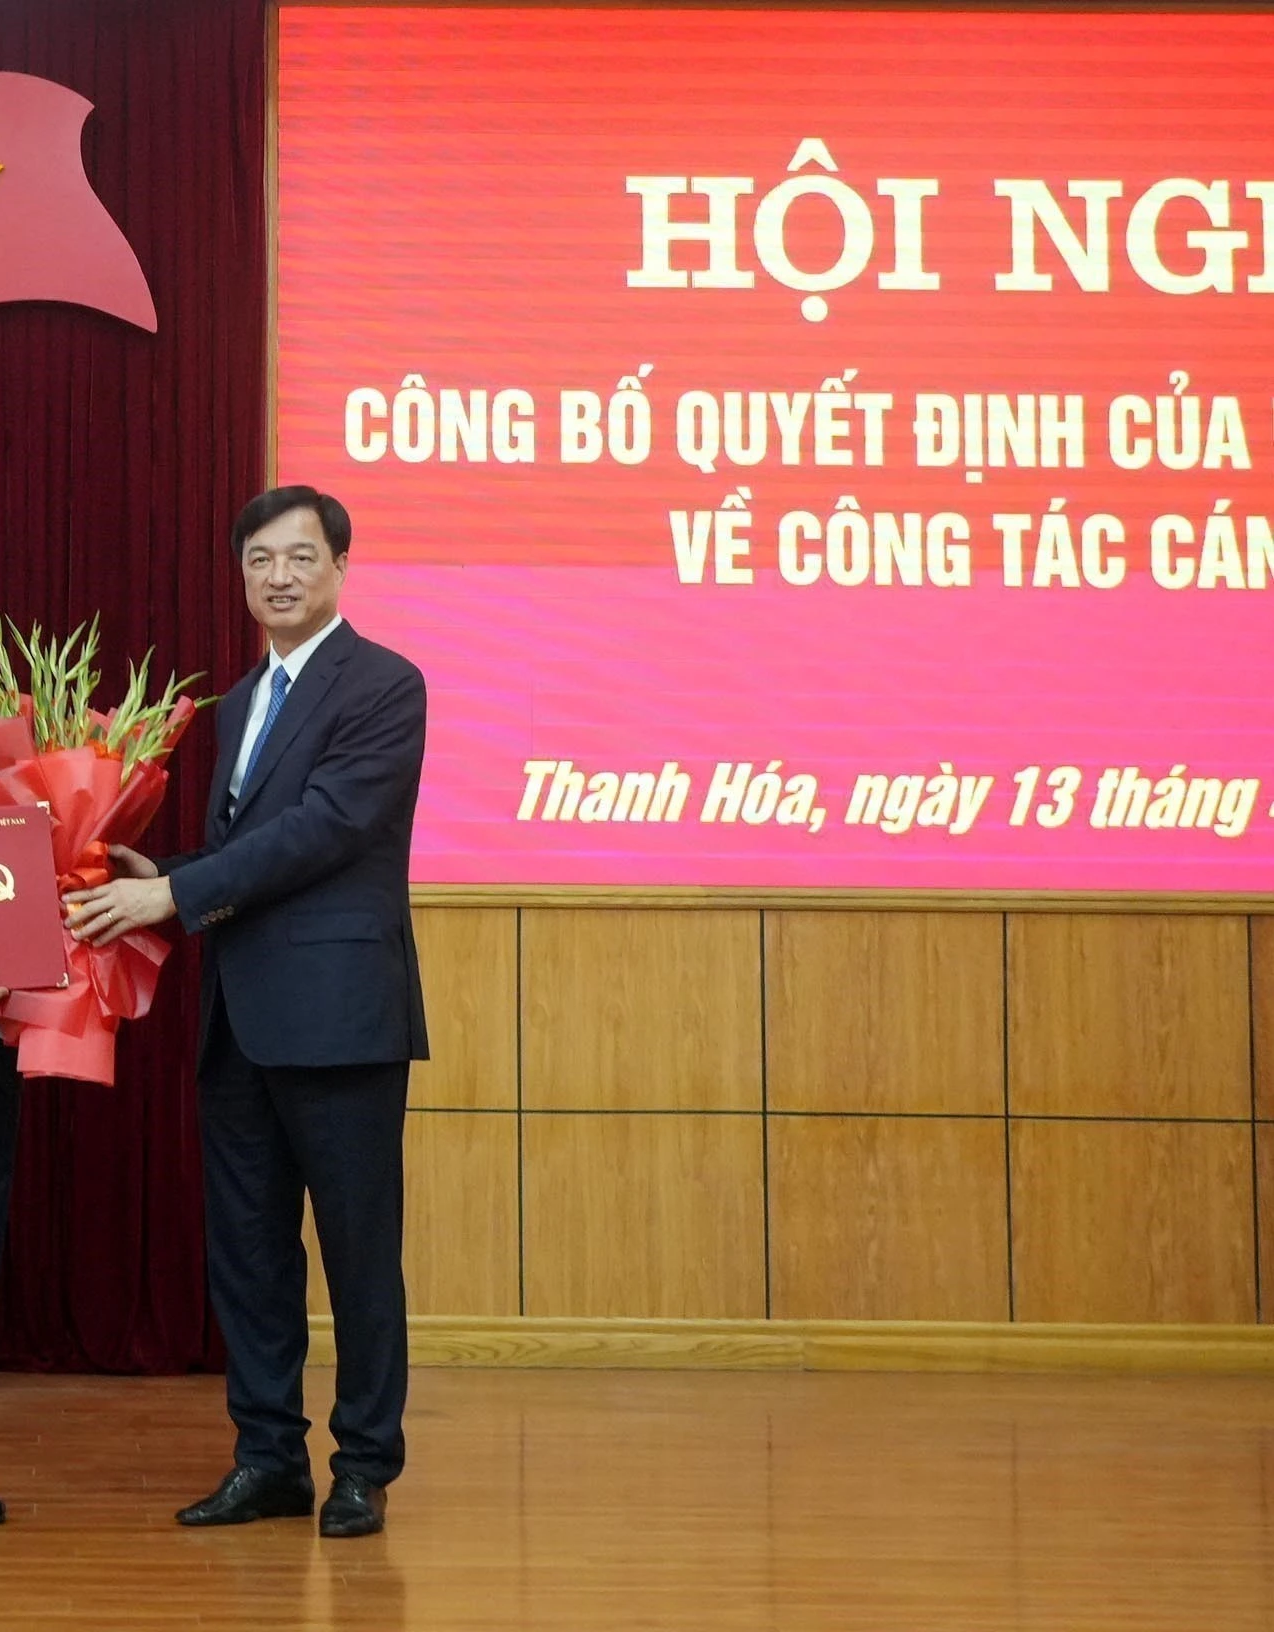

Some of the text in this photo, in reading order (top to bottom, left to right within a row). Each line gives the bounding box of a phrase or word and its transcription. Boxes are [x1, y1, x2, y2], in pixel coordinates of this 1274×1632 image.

[625, 138, 1274, 322] HỘI NG
[344, 362, 1252, 484] CÔNG BỐ QUYẾT ĐỊNH CỦA
[669, 485, 754, 585] VỀ
[778, 495, 971, 588] CÔNG
[992, 497, 1127, 589] TÁC
[516, 759, 1260, 838] Thanh Hóa, ngày 13 tháng
